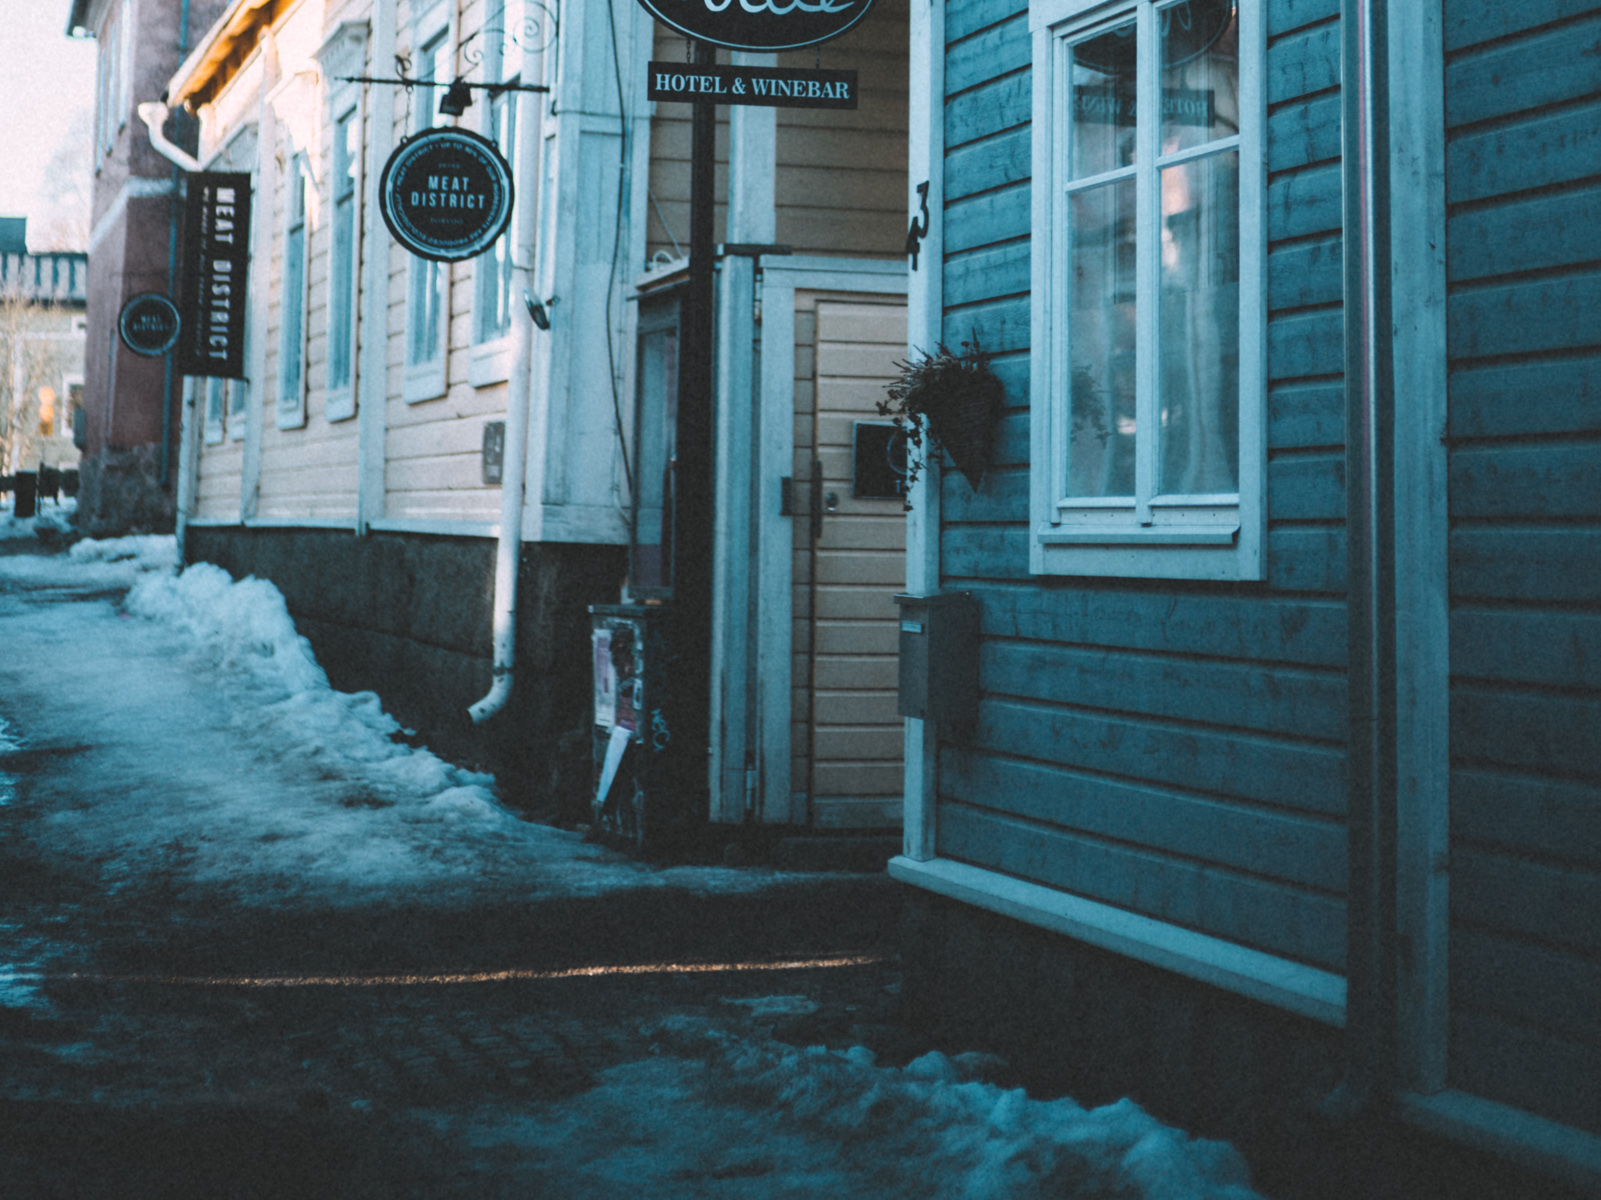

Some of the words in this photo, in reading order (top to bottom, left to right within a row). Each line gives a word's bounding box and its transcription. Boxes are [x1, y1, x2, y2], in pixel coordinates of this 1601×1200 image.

[655, 73, 728, 94] HOTEL
[731, 76, 747, 95] &
[751, 78, 850, 100] WINEBAR
[440, 141, 451, 149] UP
[453, 141, 463, 150] TO
[405, 143, 434, 167] DISTRICT
[478, 155, 488, 165] OF
[396, 165, 408, 186] MEAT
[486, 165, 497, 181] OUR
[428, 175, 470, 192] MEAT
[411, 191, 486, 209] DISTRICT
[214, 186, 236, 245] MEAT
[469, 228, 482, 240] ARE
[208, 259, 233, 361] DISTRICT
